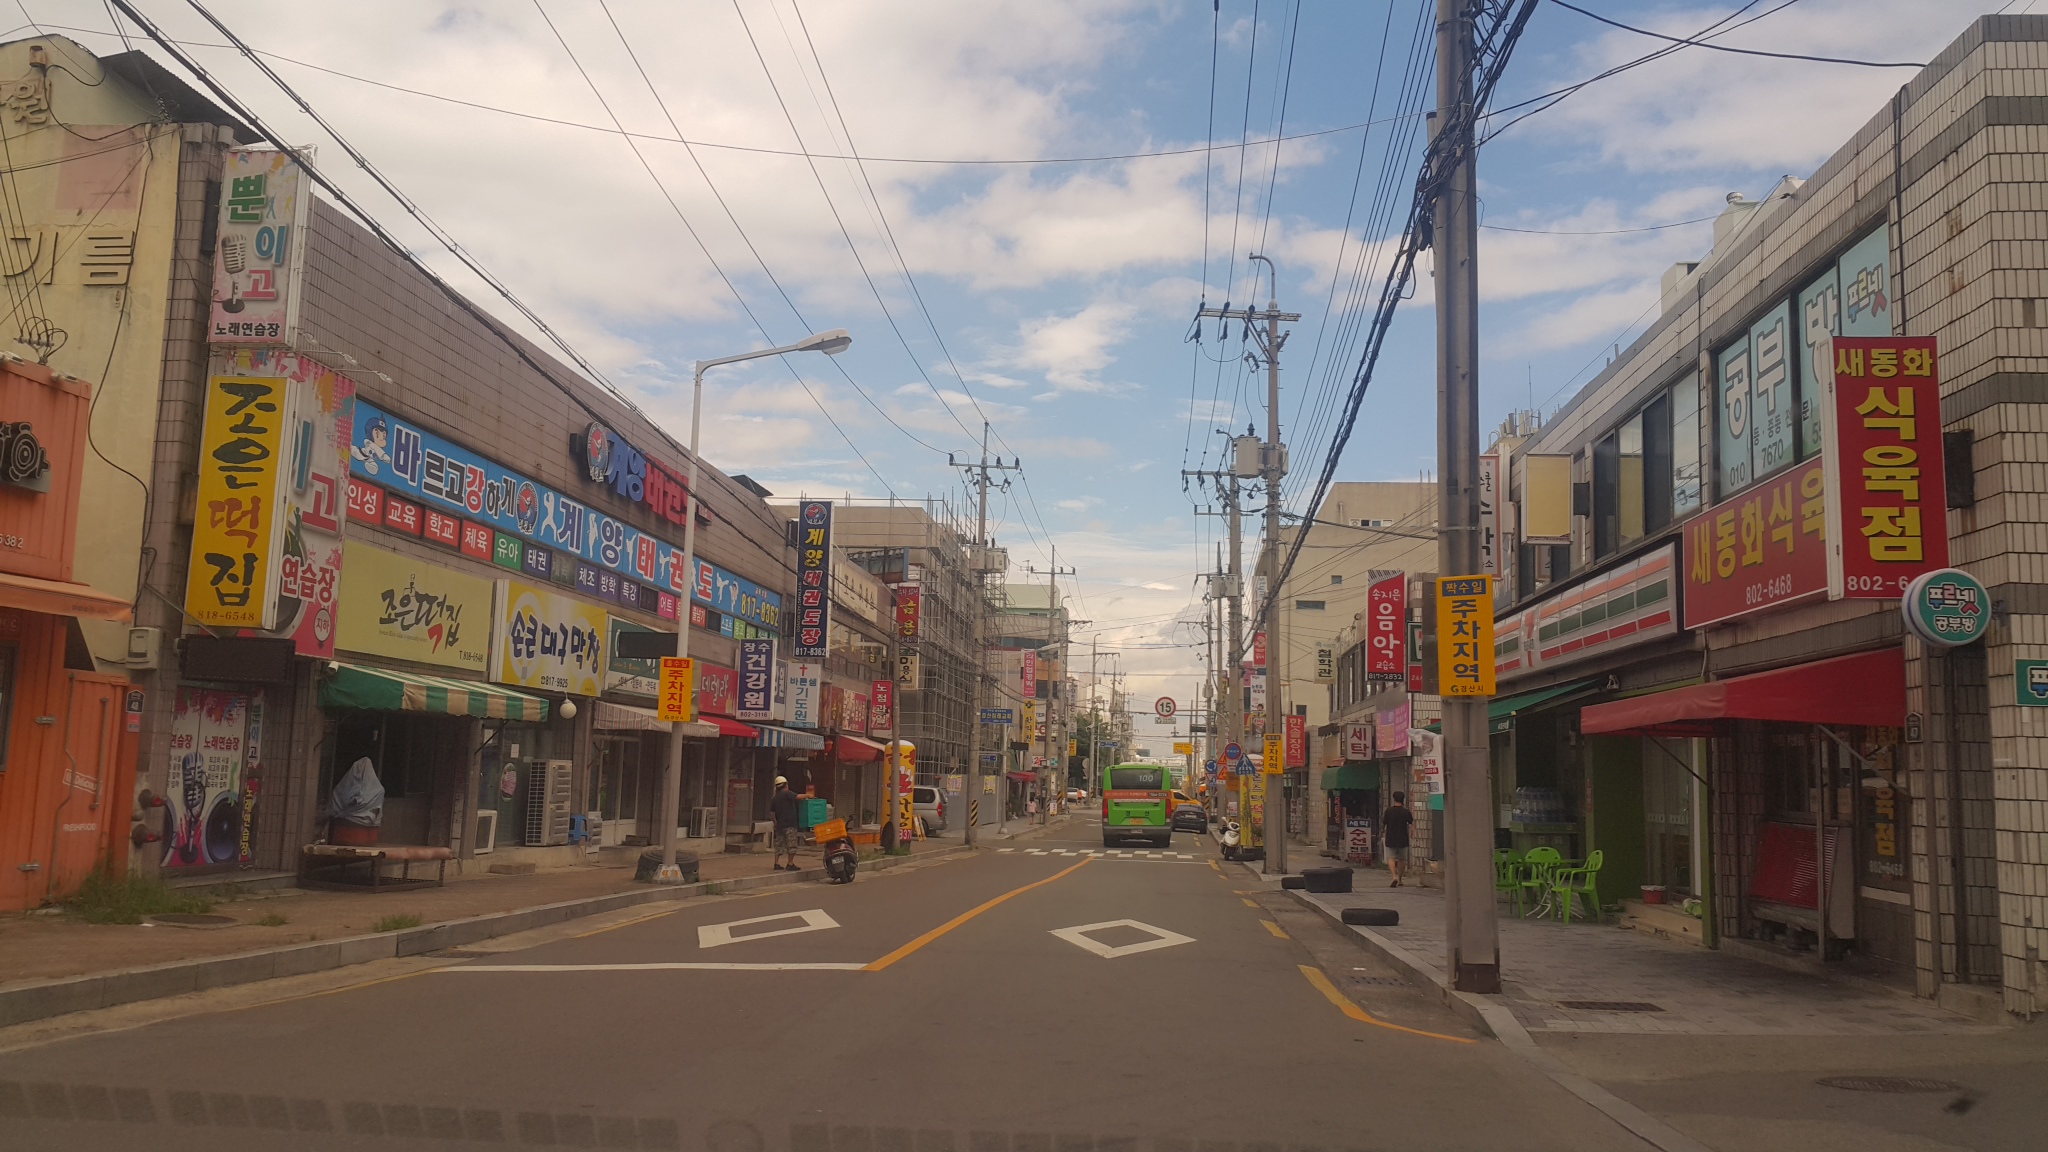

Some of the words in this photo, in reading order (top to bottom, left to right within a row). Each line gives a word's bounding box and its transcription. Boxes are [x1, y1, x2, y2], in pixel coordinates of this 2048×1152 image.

[214, 322, 280, 337] 노래연습장
[1836, 347, 1933, 378] 새동화
[1729, 461, 1745, 487] 010
[1760, 440, 1783, 469] 7670
[1855, 386, 1924, 562] 식육점
[203, 382, 277, 608] 조은떡집
[348, 485, 377, 515] 인성
[388, 501, 415, 529] 교육
[430, 513, 454, 539] 학교
[464, 527, 488, 552] 체육
[498, 537, 518, 562] 유아
[527, 547, 547, 571] 태권
[578, 567, 595, 587] 체조
[601, 575, 617, 595] 방학
[622, 581, 637, 601] 특강
[281, 558, 336, 603] 연습장
[803, 528, 824, 646] 계양태권도장
[1371, 588, 1400, 601] 송지은
[1446, 581, 1482, 595] 짝수일
[1745, 574, 1791, 605] 802-6468
[1847, 575, 1909, 592] 802-6
[197, 610, 255, 622] 818-6548
[741, 592, 780, 628] 817-8362
[1935, 616, 1975, 633] 공부방
[315, 617, 331, 634] 지하
[1373, 602, 1400, 659] 음악
[743, 643, 770, 653] 장수
[795, 647, 826, 657] 817-8362
[1452, 599, 1480, 683] 주차지역
[1317, 648, 1333, 678] 철학관
[1375, 660, 1395, 670] 교습소
[666, 669, 685, 715] 주차지역
[744, 654, 767, 709] 건강원
[1461, 685, 1484, 693] 경산시
[795, 688, 808, 721] 기도원
[874, 684, 893, 724] 노점과일
[1160, 702, 1172, 713] 15
[203, 735, 241, 751] 노래연습장
[1268, 741, 1279, 770] 주차지역
[1350, 727, 1369, 758] 세탁
[1349, 828, 1367, 846] 수선
